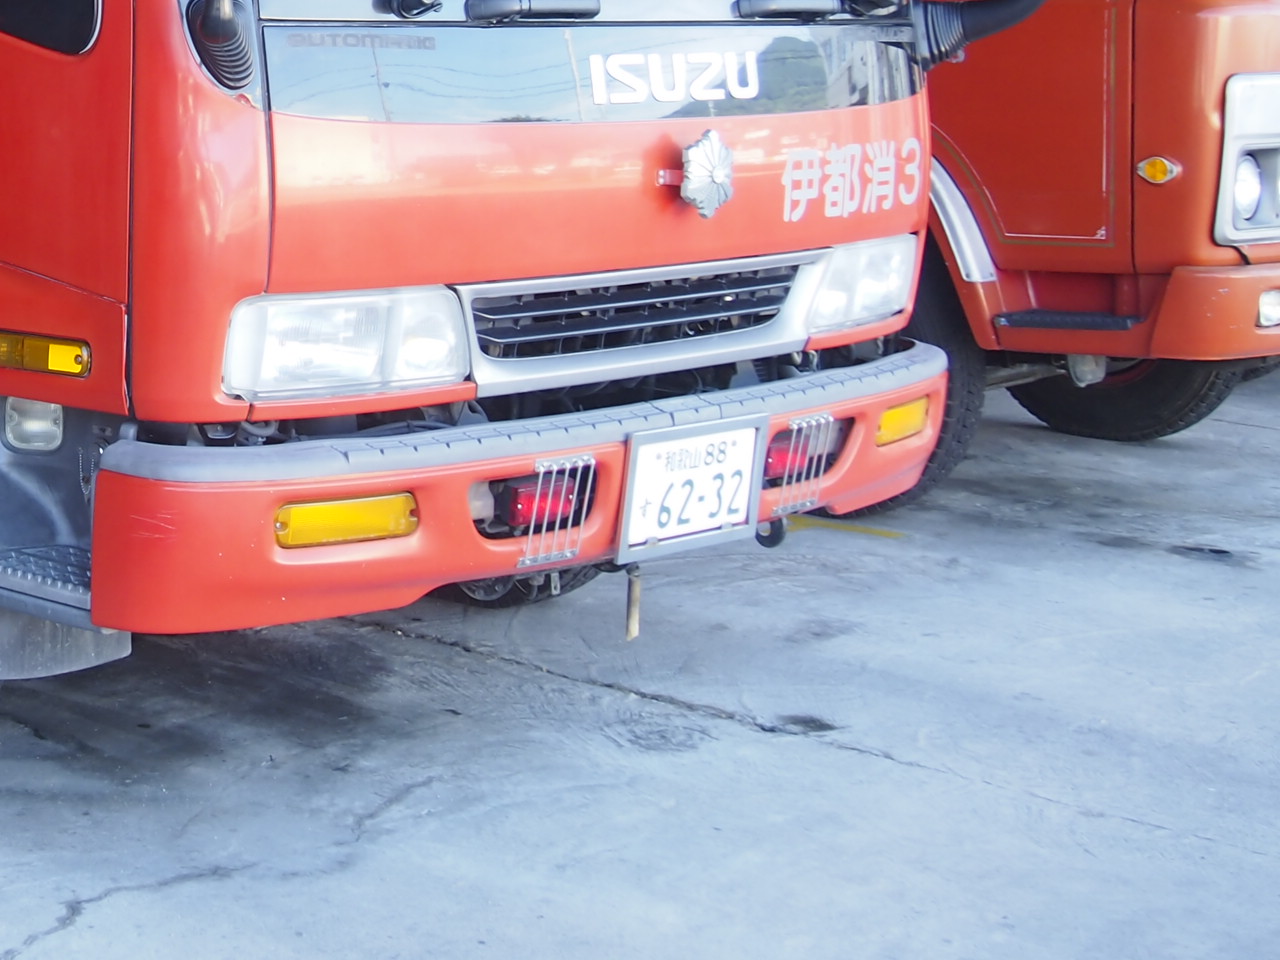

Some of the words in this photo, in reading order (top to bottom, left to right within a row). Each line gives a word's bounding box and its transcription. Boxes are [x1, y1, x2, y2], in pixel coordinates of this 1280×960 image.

[589, 50, 760, 106] ISUZU
[781, 137, 921, 223] 伊都消3
[656, 469, 744, 529] 62-32
